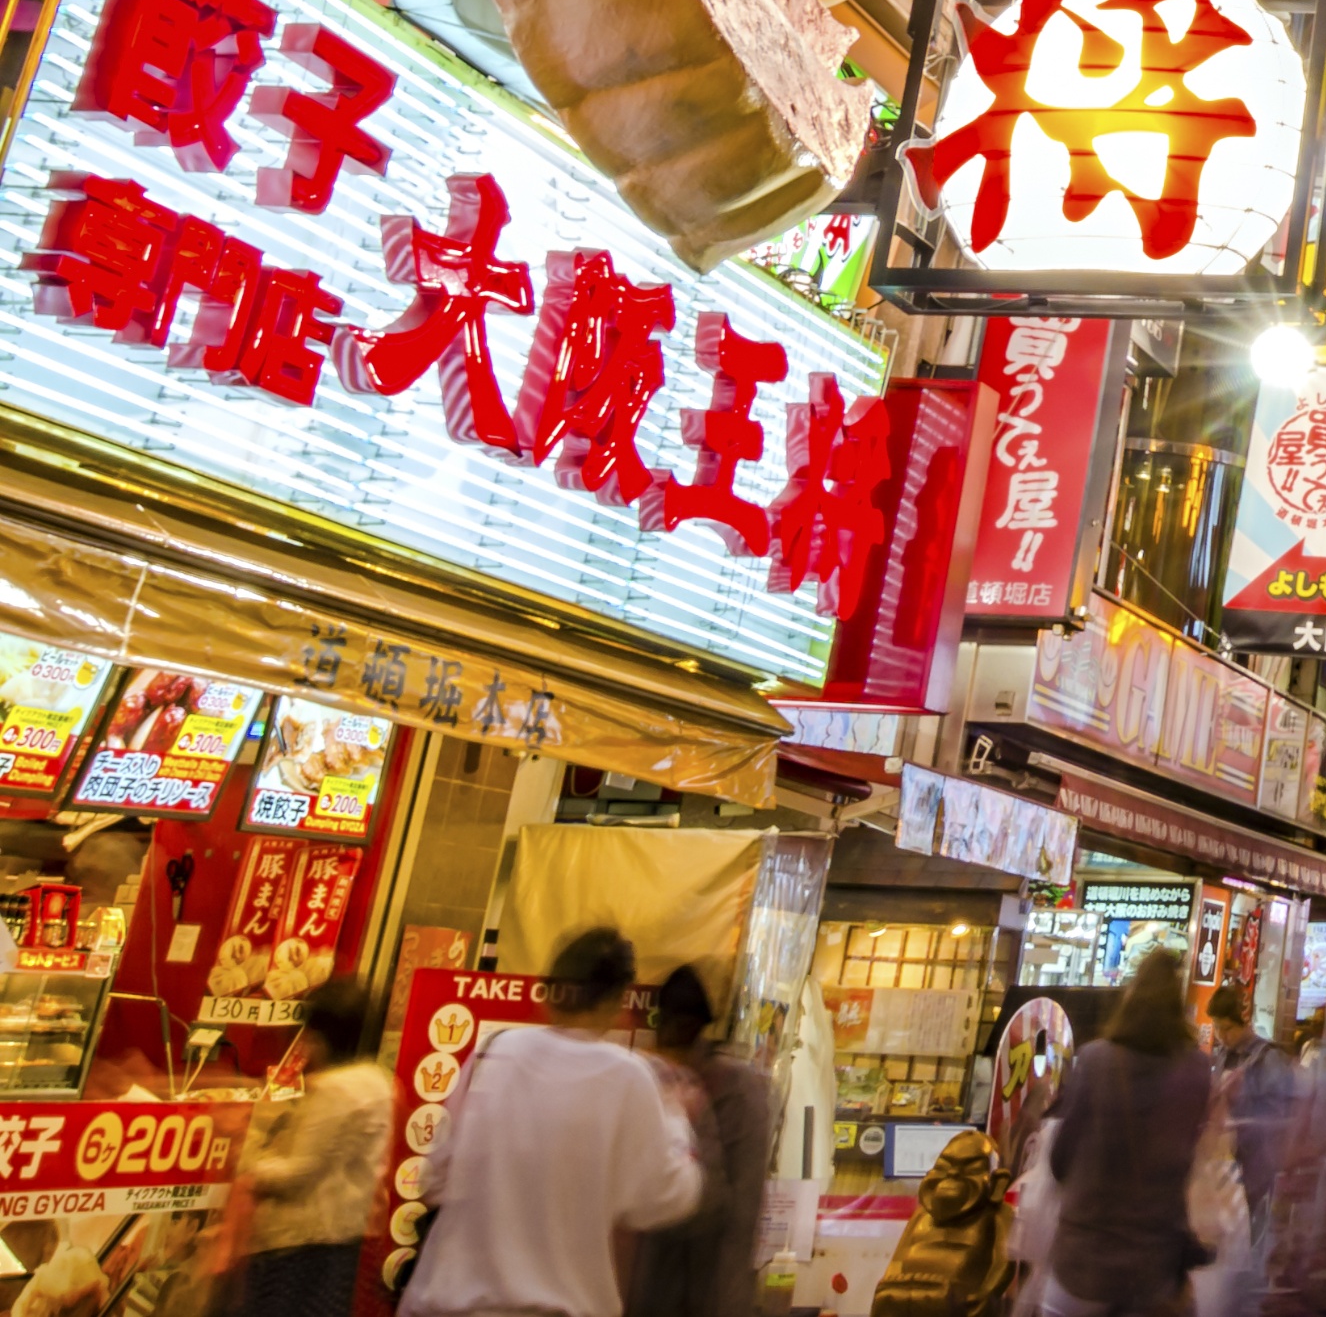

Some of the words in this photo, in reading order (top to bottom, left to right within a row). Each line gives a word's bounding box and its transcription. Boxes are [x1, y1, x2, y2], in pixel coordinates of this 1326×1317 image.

[94, 754, 161, 776] チーズ入り
[82, 775, 213, 807] 肉団子のチリソース
[255, 793, 308, 822] 焼餃子
[243, 853, 287, 935] 豚まん
[298, 856, 340, 937] 豚まん
[453, 976, 524, 1002] TAKE
[430, 1071, 443, 1091] 2
[116, 1114, 231, 1173] 200円
[33, 1191, 106, 1215] GYOZA
